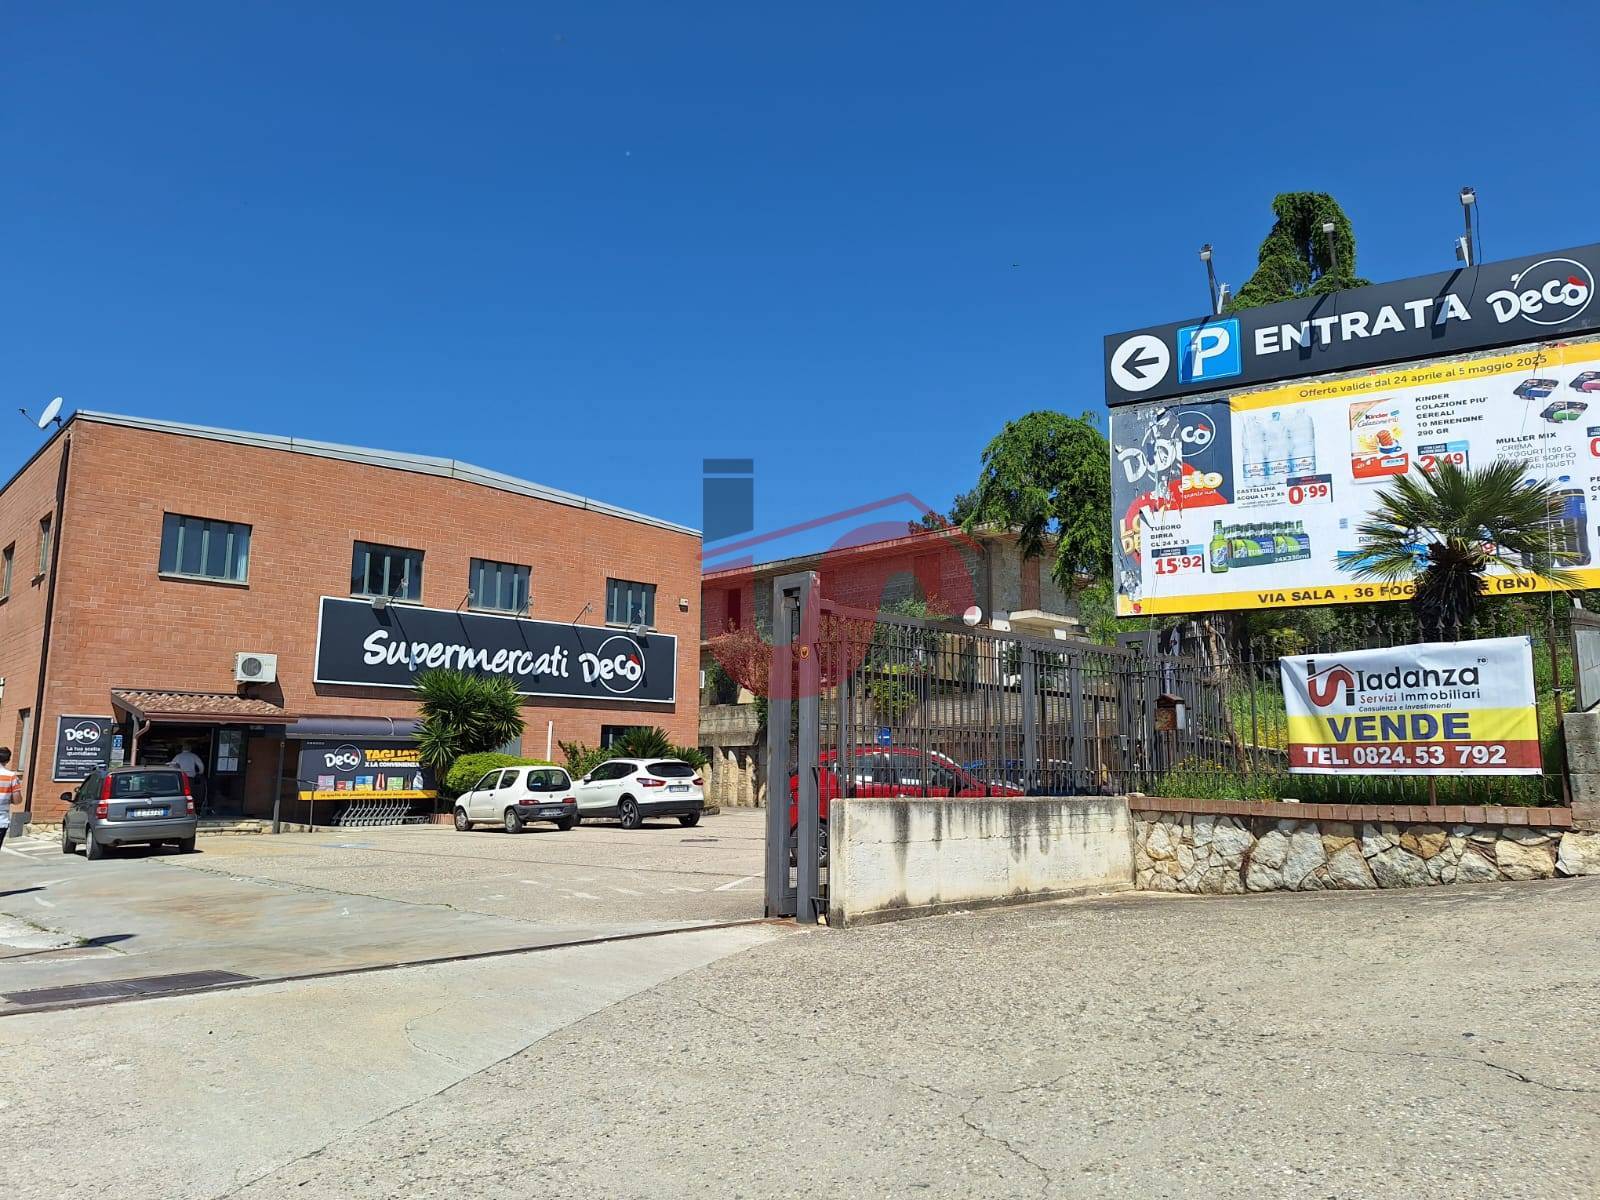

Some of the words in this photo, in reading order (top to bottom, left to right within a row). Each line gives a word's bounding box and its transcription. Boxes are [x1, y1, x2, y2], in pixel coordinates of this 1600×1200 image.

[1255, 294, 1471, 355] ENTRATA
[1300, 386, 1337, 398] Offerte
[1341, 381, 1371, 393] valide
[1374, 378, 1391, 389] dal
[1394, 376, 1407, 385] 24
[1411, 371, 1442, 384] aprile
[1446, 369, 1456, 378] al
[1459, 367, 1465, 375] 5
[1468, 361, 1513, 376] maggio
[1517, 355, 1547, 367] 2025
[1415, 393, 1450, 402] KINDER
[1416, 400, 1468, 411] COLAZIONE
[1416, 410, 1455, 419] CEREALI
[1430, 415, 1484, 426] MERENDINE
[1496, 434, 1535, 445] MULLER
[1502, 442, 1533, 451] CREMA
[1508, 448, 1544, 458] YOGURT
[1546, 460, 1574, 468] GUSTI
[1237, 486, 1276, 494] CASTELLINA
[1258, 593, 1285, 603] VIA
[1291, 590, 1335, 601] SALA
[1354, 587, 1374, 598] 36
[1496, 577, 1537, 592] (BN)
[363, 629, 569, 678] Supermercati
[1355, 666, 1480, 692] Iadanza
[1360, 692, 1397, 704] Servizi
[1401, 688, 1481, 701] Immobiliari
[1358, 705, 1398, 713] Consulenza
[1327, 712, 1472, 742] VENDE
[1303, 747, 1349, 765] TEL.
[1456, 745, 1507, 764] 792
